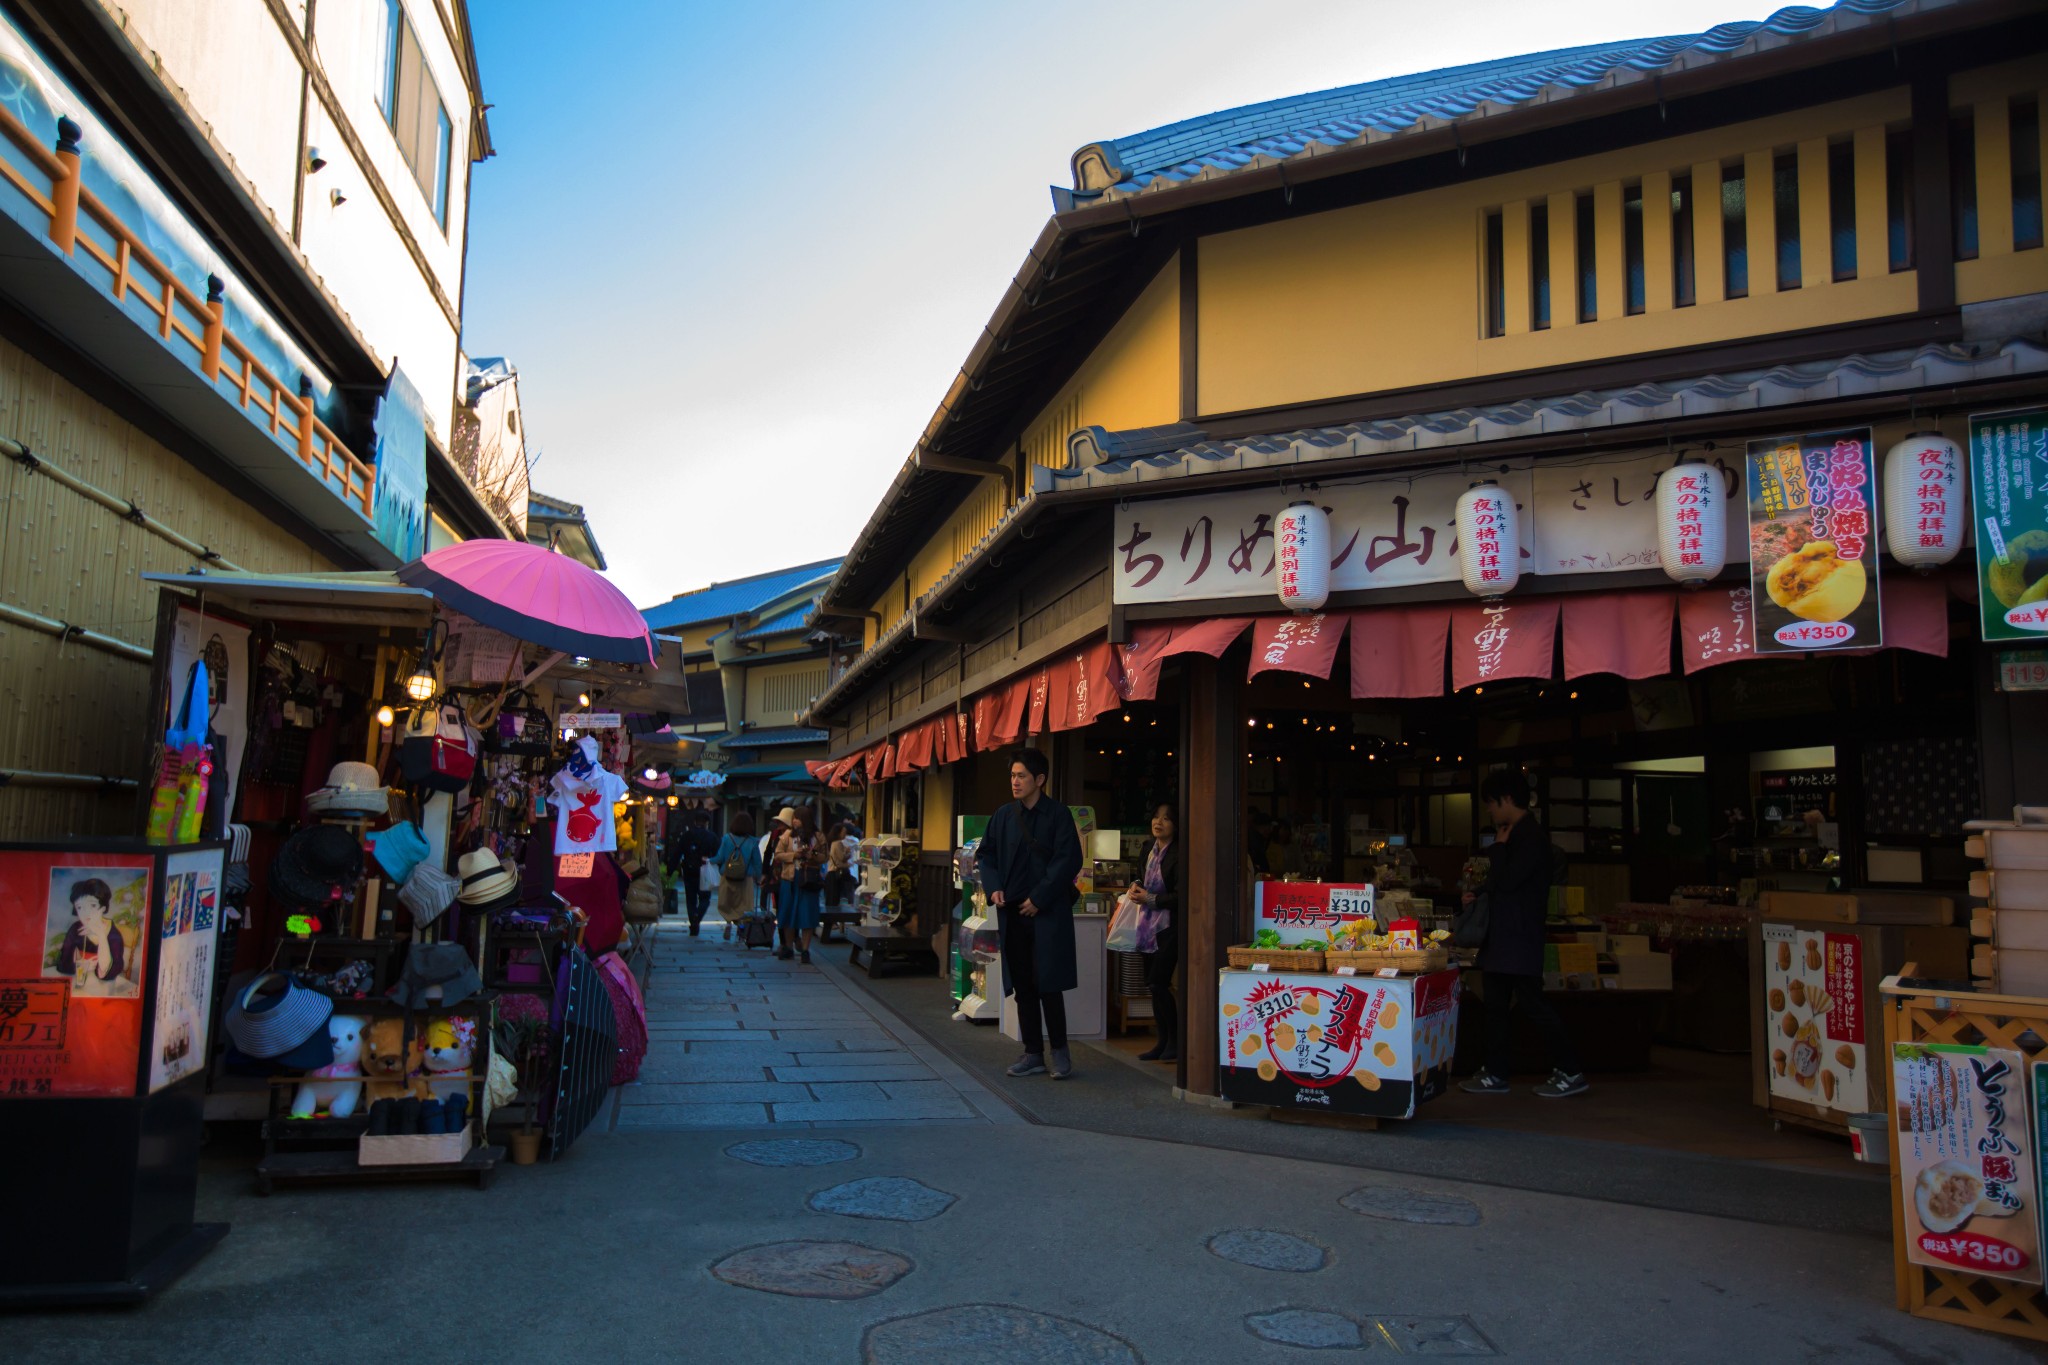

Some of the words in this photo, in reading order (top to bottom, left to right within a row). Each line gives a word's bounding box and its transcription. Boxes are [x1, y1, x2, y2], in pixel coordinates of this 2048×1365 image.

[1779, 447, 1806, 505] チーズ入り
[1944, 446, 1956, 485] 清水寺
[1699, 472, 1711, 508] 清水寺
[1806, 450, 1830, 538] まんじゅう
[1830, 440, 1868, 560] お好み焼き
[1917, 449, 1946, 547] 夜の特別拝観
[1297, 515, 1308, 547] 清水寺
[1493, 500, 1507, 533] 清水寺
[1676, 476, 1703, 565] 夜の特別拝観
[1118, 494, 1531, 589] ちりめ山
[1281, 518, 1300, 598] 夜の特別拝観
[1473, 498, 1501, 581] 夜の特別拝観
[1728, 586, 1752, 653] ゆどうふ
[1777, 630, 1797, 641] 税込
[1798, 625, 1848, 641] ¥350
[2009, 613, 2032, 624] 税込
[1273, 904, 1342, 926] カステラ
[1331, 898, 1371, 913] ¥310
[1253, 992, 1293, 1019] ¥310
[1362, 988, 1386, 1040] 当店自家製
[1310, 985, 1354, 1079] カステラ
[1481, 1077, 1494, 1087] N
[1556, 1080, 1570, 1091] N
[1968, 1056, 2023, 1212] とうふ豚まん
[1923, 1238, 1949, 1254] 税込
[1950, 1240, 2021, 1267] ¥350
